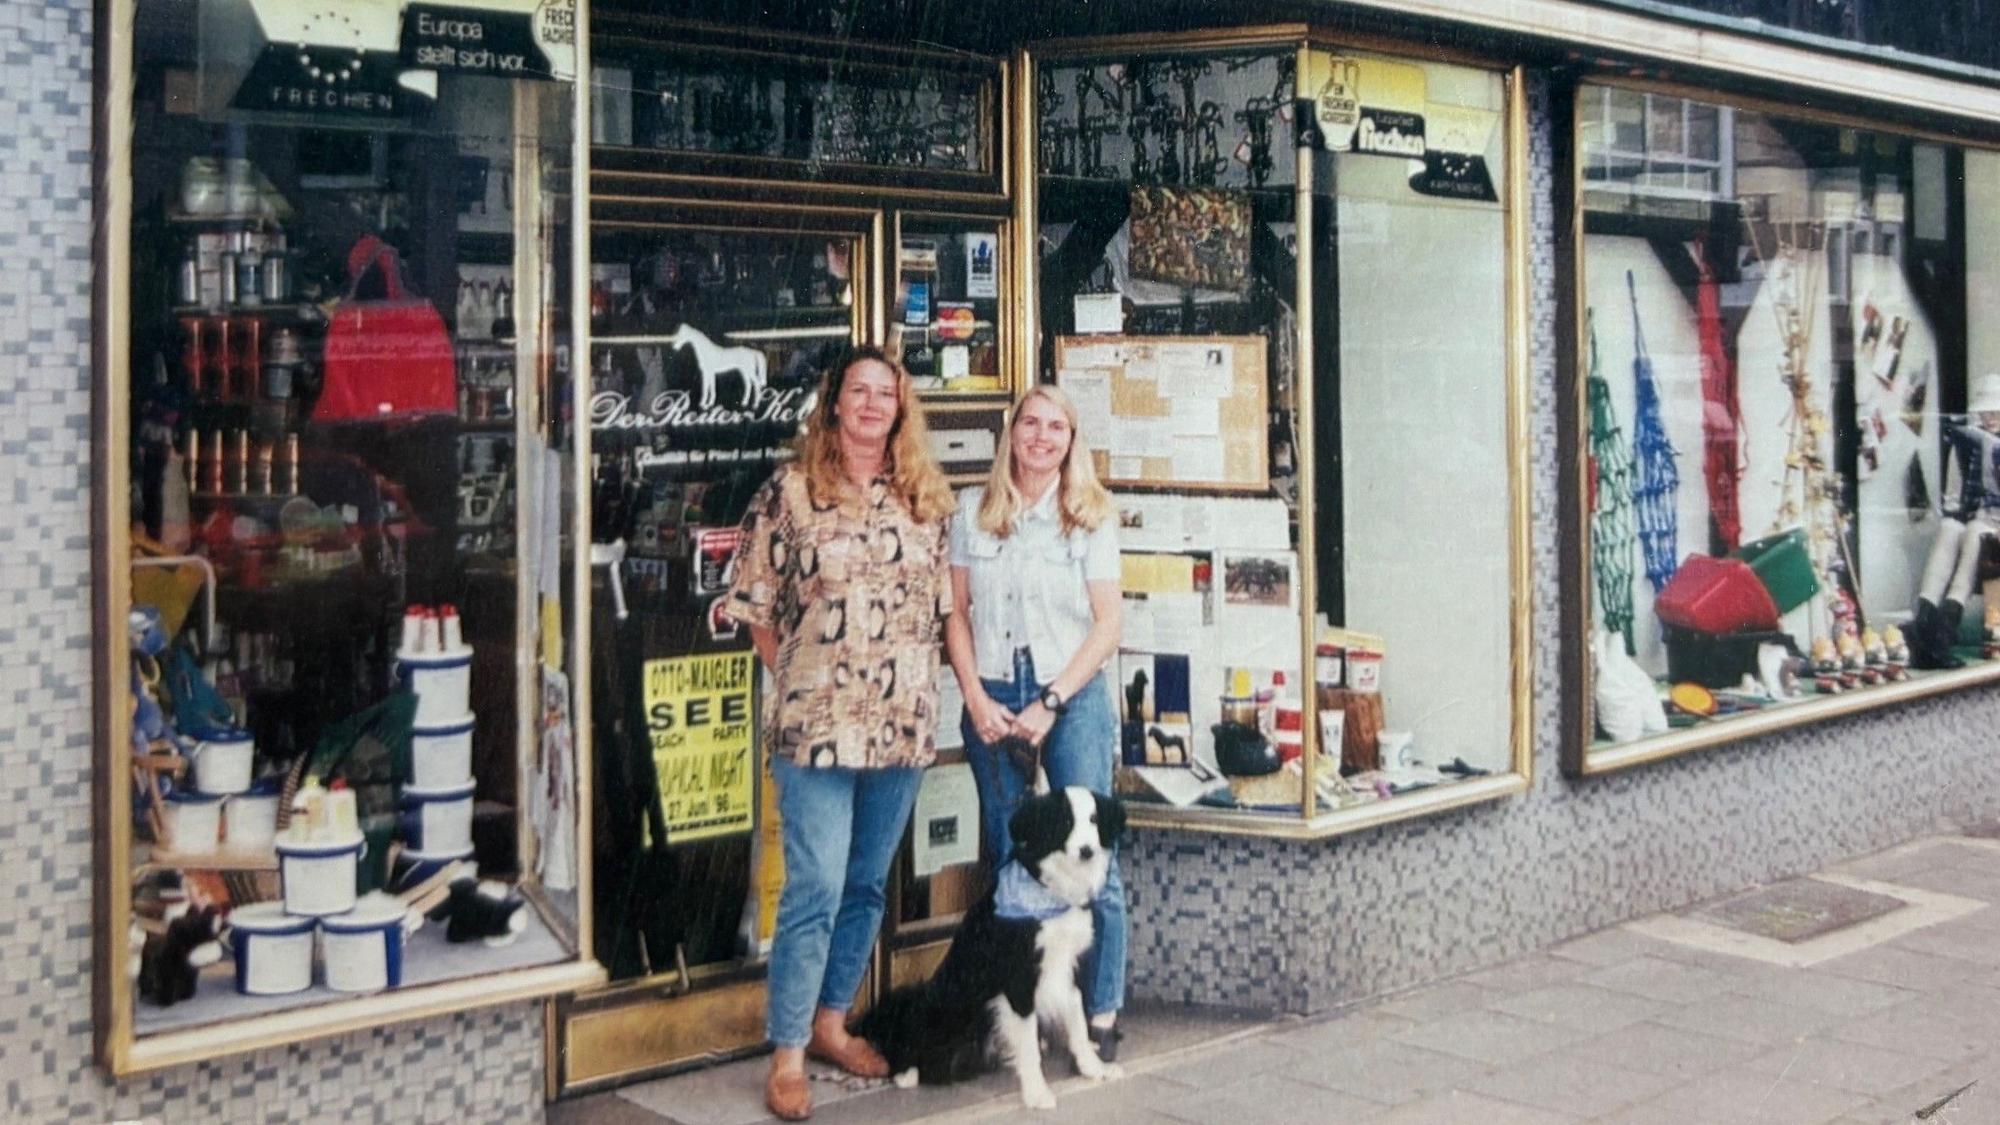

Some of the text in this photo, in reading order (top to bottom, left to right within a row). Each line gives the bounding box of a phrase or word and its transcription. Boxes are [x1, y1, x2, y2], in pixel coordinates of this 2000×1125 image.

[418, 12, 483, 41] Europa
[417, 45, 456, 67] stellt
[458, 48, 496, 69] sich
[272, 86, 394, 110] FRECHEN
[591, 390, 653, 430] Der
[651, 389, 755, 428] Reiter
[650, 694, 748, 730] SEE
[653, 725, 748, 751] EACH PARTY
